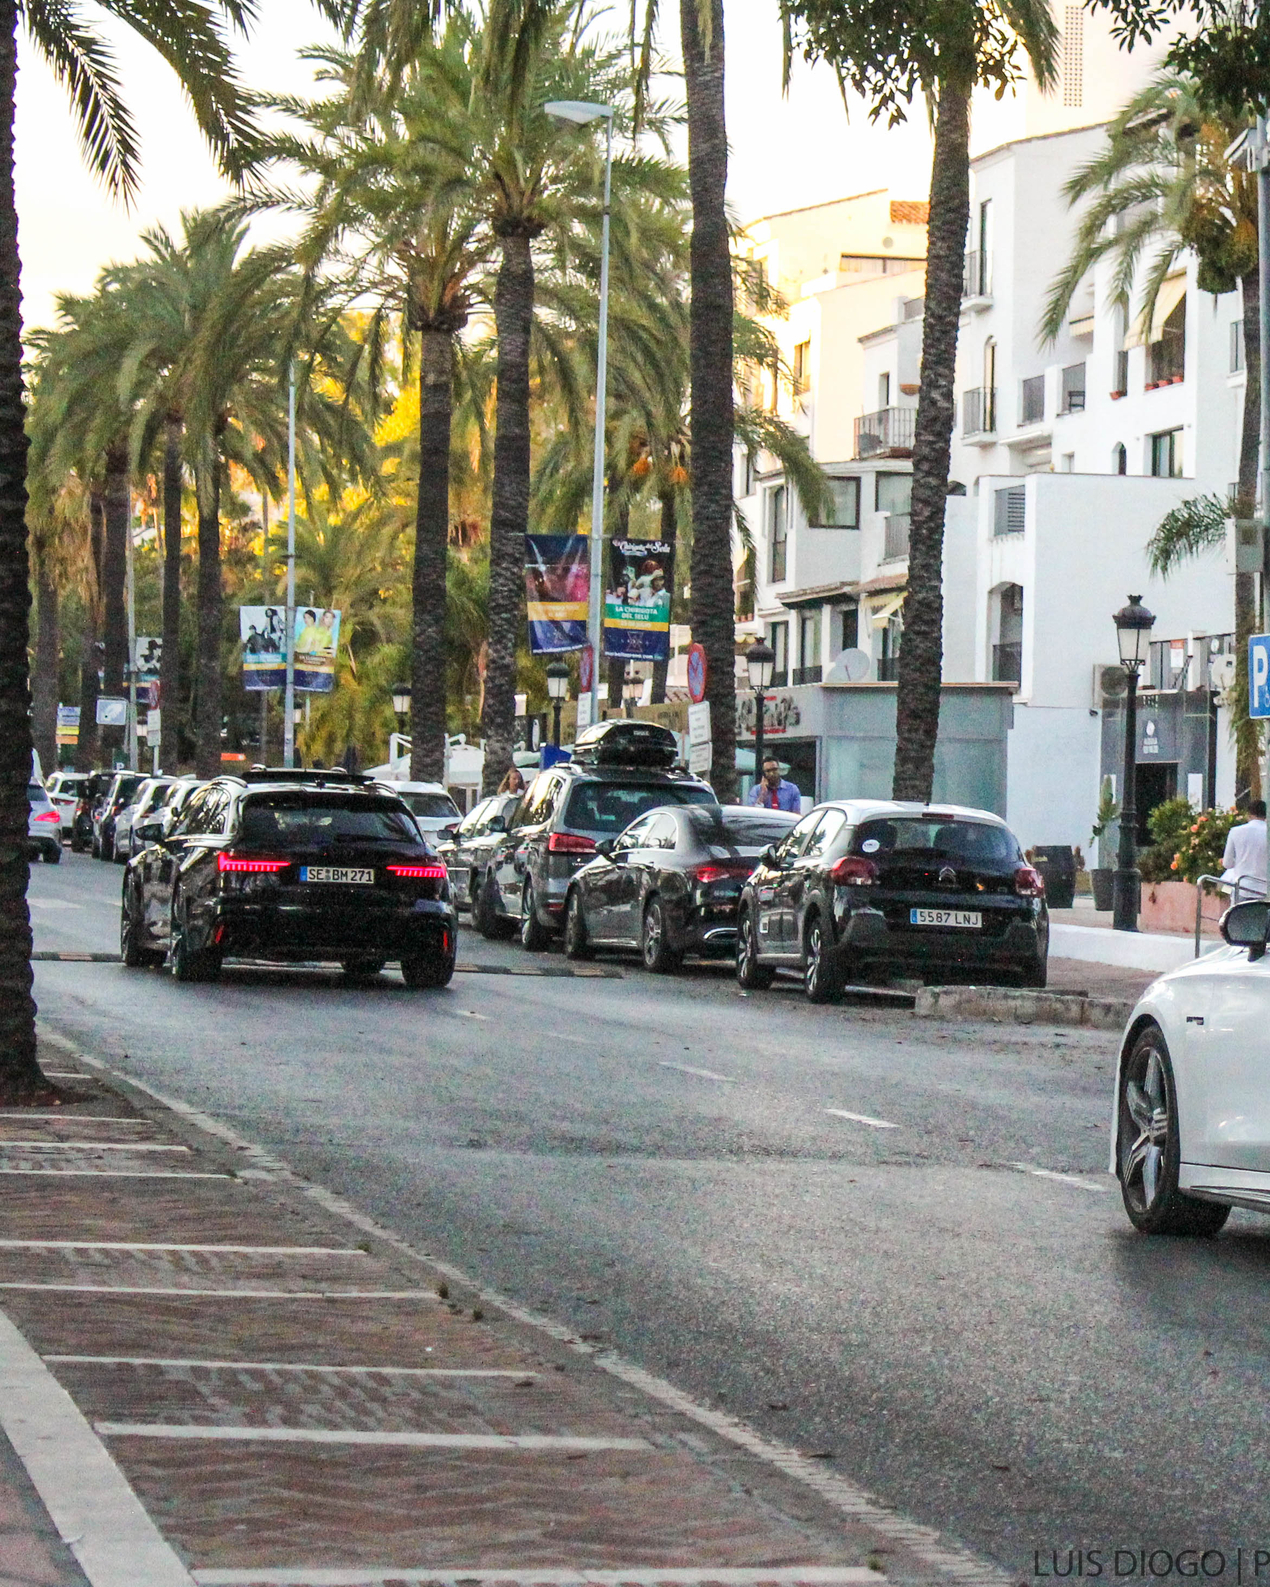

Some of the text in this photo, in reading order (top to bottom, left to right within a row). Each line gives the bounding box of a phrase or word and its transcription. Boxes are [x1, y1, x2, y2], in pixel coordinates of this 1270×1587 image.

[1253, 645, 1268, 708] P
[309, 868, 373, 882] SE BM 271
[919, 911, 980, 926] 5587 LNJ
